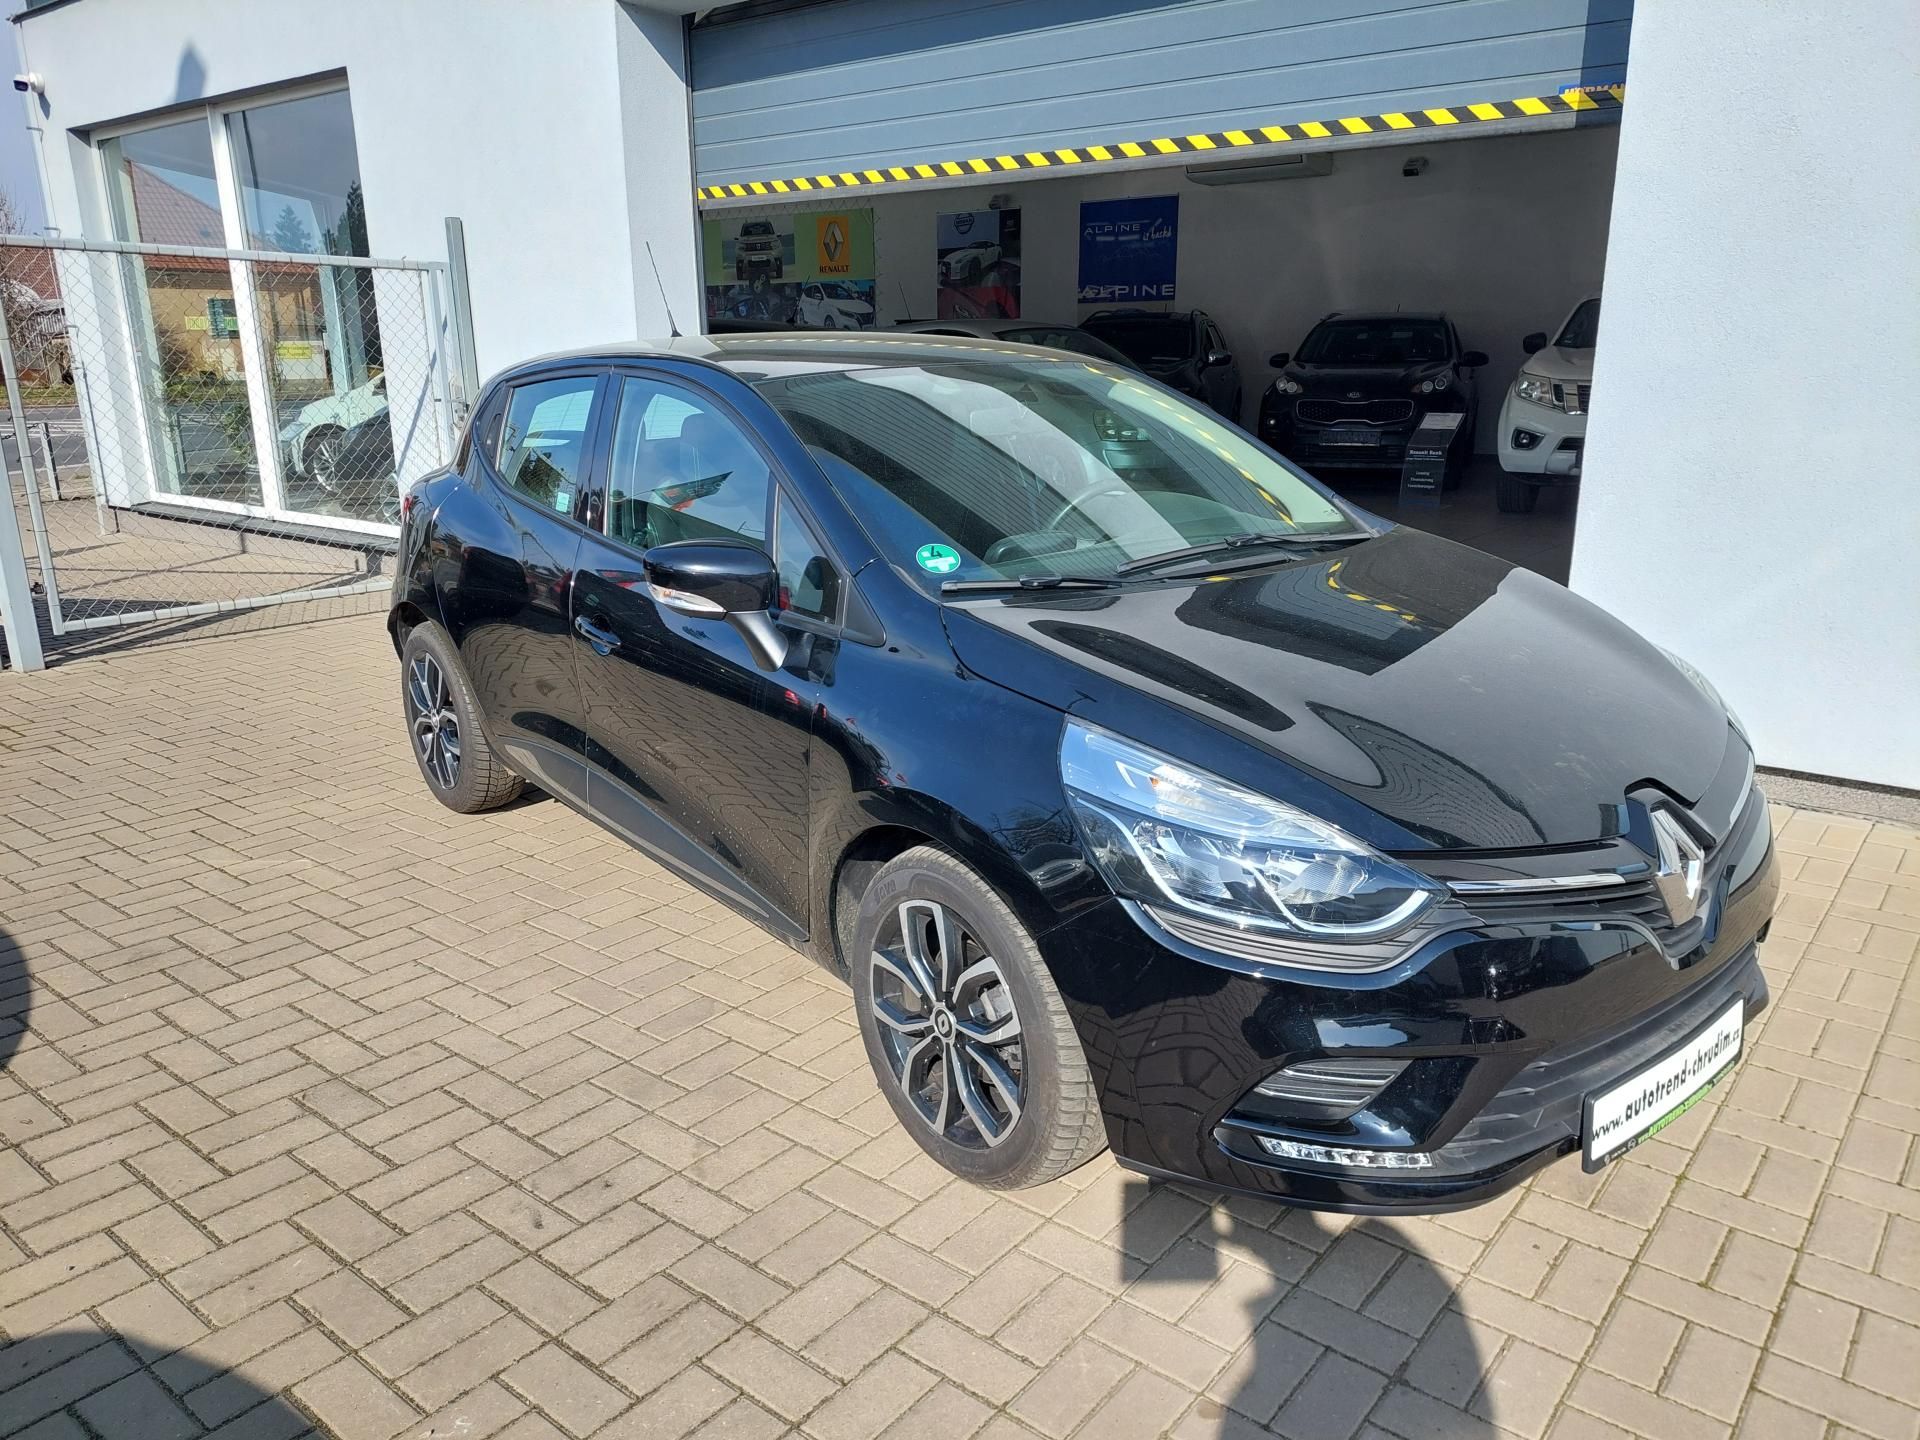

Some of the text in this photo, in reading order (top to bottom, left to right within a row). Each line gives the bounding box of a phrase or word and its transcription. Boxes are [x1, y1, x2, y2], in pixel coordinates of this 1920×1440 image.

[1084, 223, 1142, 235] ALPINE
[819, 264, 850, 274] RENAULT
[930, 545, 943, 558] 4
